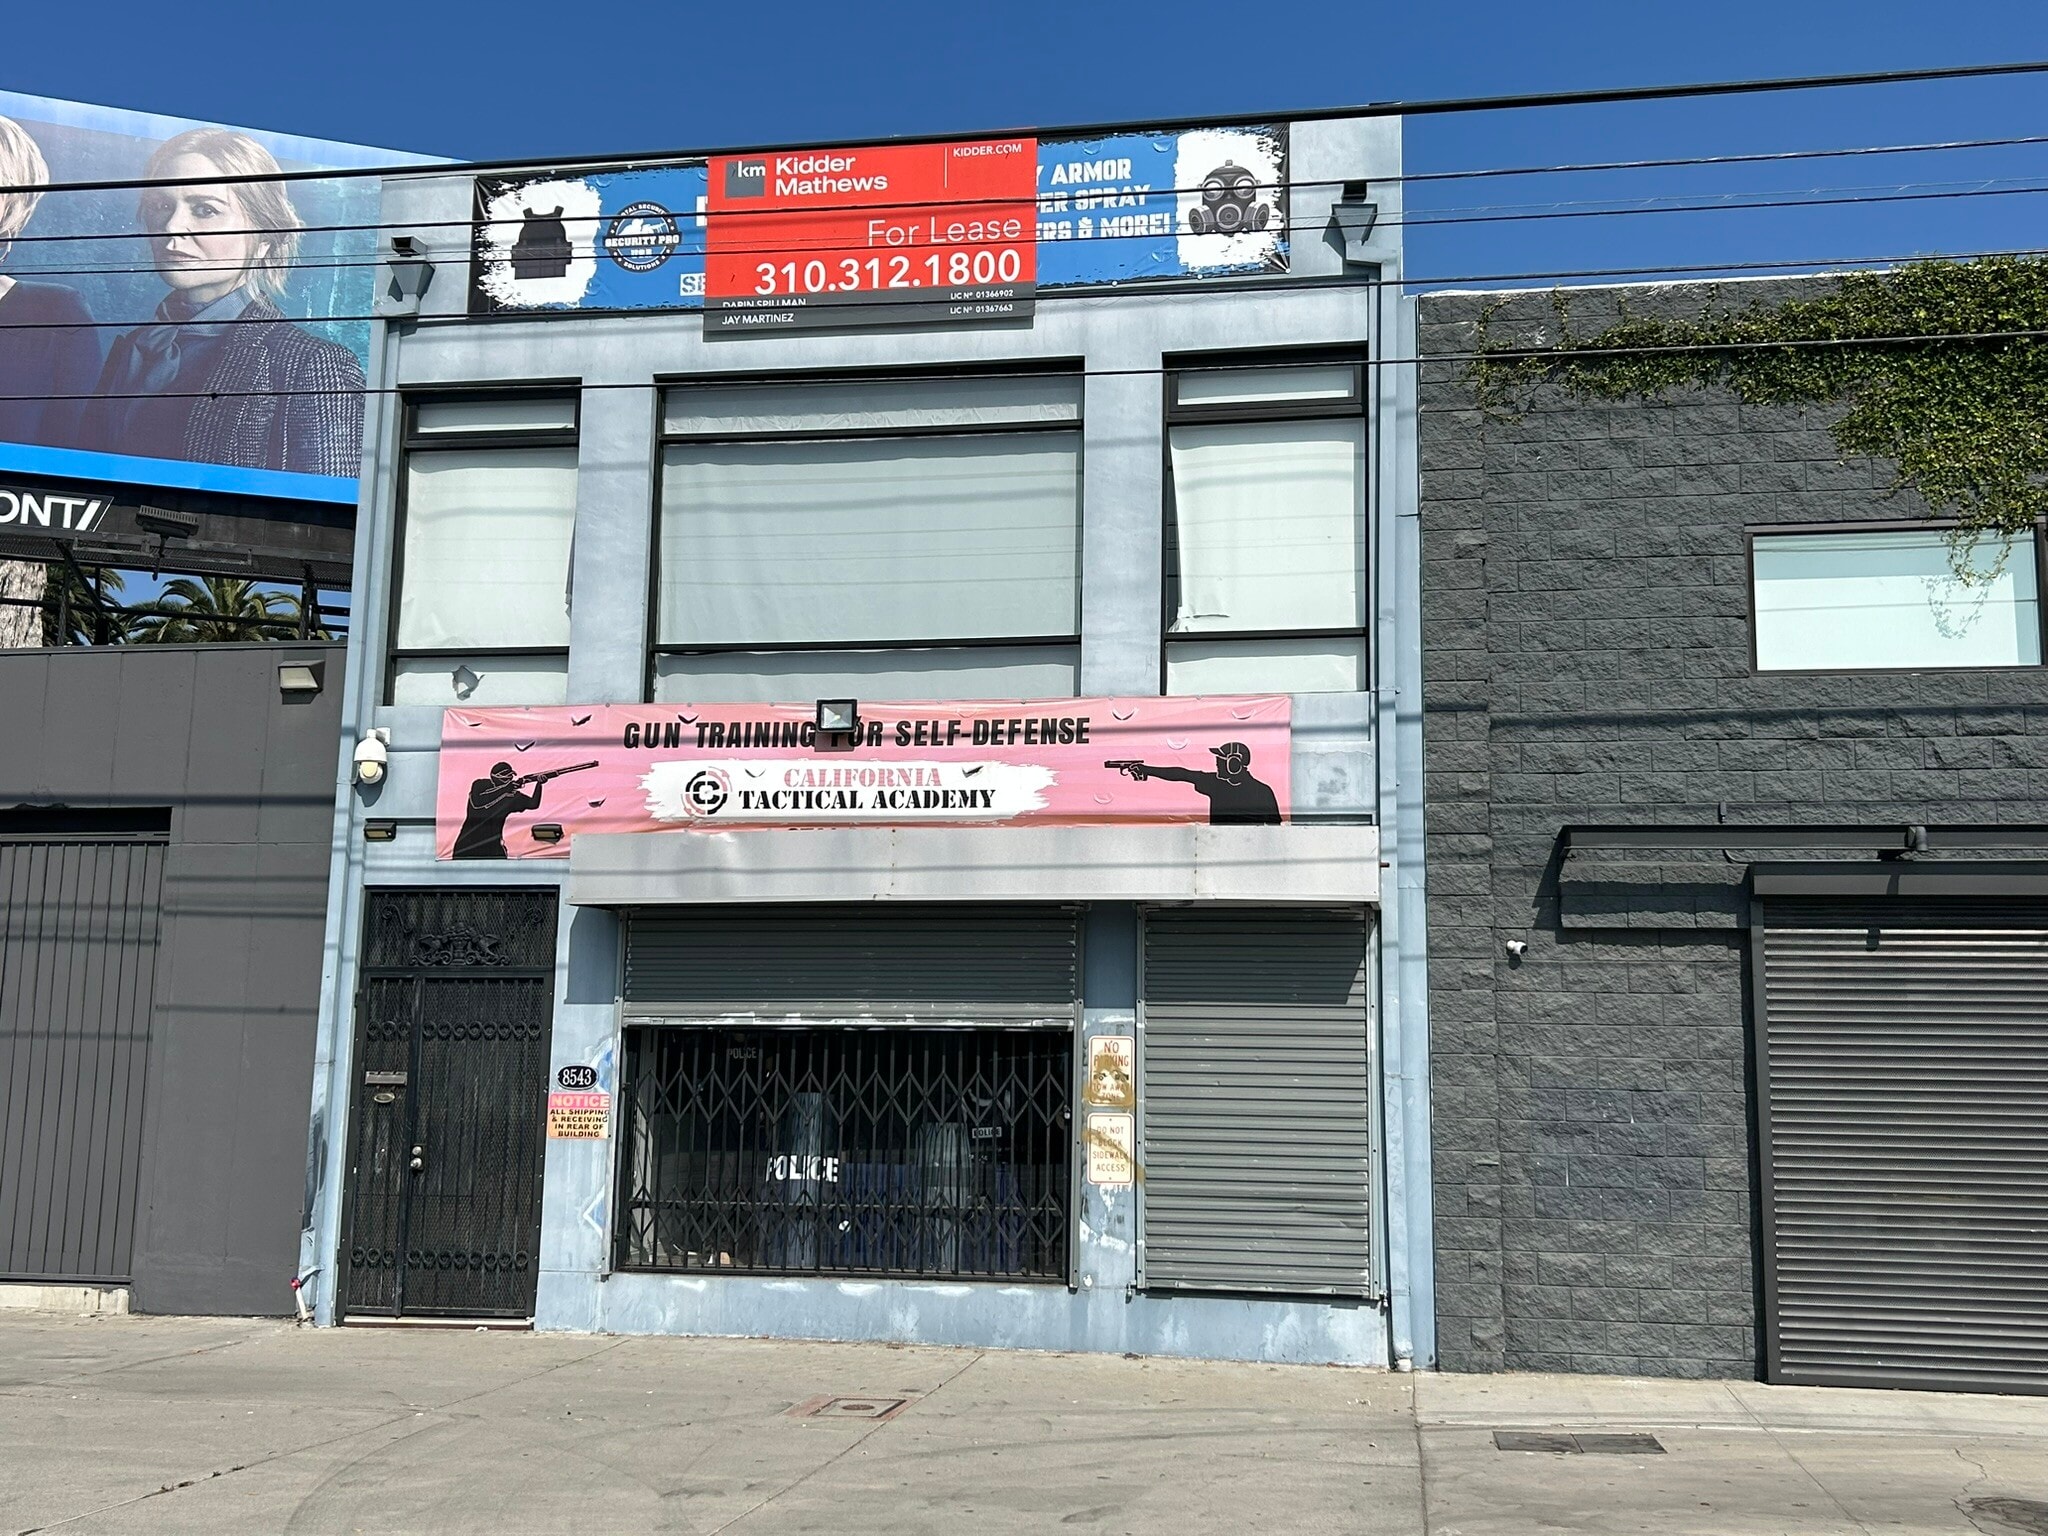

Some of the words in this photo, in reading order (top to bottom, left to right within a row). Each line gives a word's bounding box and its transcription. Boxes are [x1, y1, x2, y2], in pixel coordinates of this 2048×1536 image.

[953, 144, 1022, 158] KIDDER.COM
[738, 161, 765, 177] km
[775, 154, 857, 176] Kidder
[1050, 158, 1132, 186] ARMOR
[775, 175, 888, 197] Mathews
[1036, 191, 1069, 214] ER
[1075, 184, 1151, 211] SPRAY
[868, 219, 919, 246] For
[931, 216, 1021, 243] Lease
[1100, 213, 1170, 239] MORE!
[605, 235, 657, 247] SECURITY
[659, 234, 680, 245] PRO
[623, 259, 660, 271] SOLUTIONS
[754, 248, 1021, 295] 310.312.1800
[950, 292, 962, 300] LIC
[975, 289, 1014, 298] 01366902
[950, 306, 962, 314] LIC
[975, 303, 1013, 313] 01367663
[722, 315, 741, 325] JAY
[742, 313, 794, 324] MARTINEZ
[623, 722, 681, 749] GUN
[696, 721, 816, 749] TRAINING
[895, 717, 1091, 747] SELF-DEFENSE
[783, 767, 943, 788] CALIFORNIA
[738, 789, 864, 810] TACTICAL
[871, 789, 996, 809] ACADEMY
[1103, 1041, 1120, 1054] NO
[1093, 1054, 1129, 1067] PKING
[562, 1068, 592, 1086] 8543
[551, 1095, 610, 1107] NOTICE
[1109, 1125, 1124, 1135] NOT
[766, 1154, 839, 1183] POLICE
[1096, 1163, 1125, 1172] ACCESS
